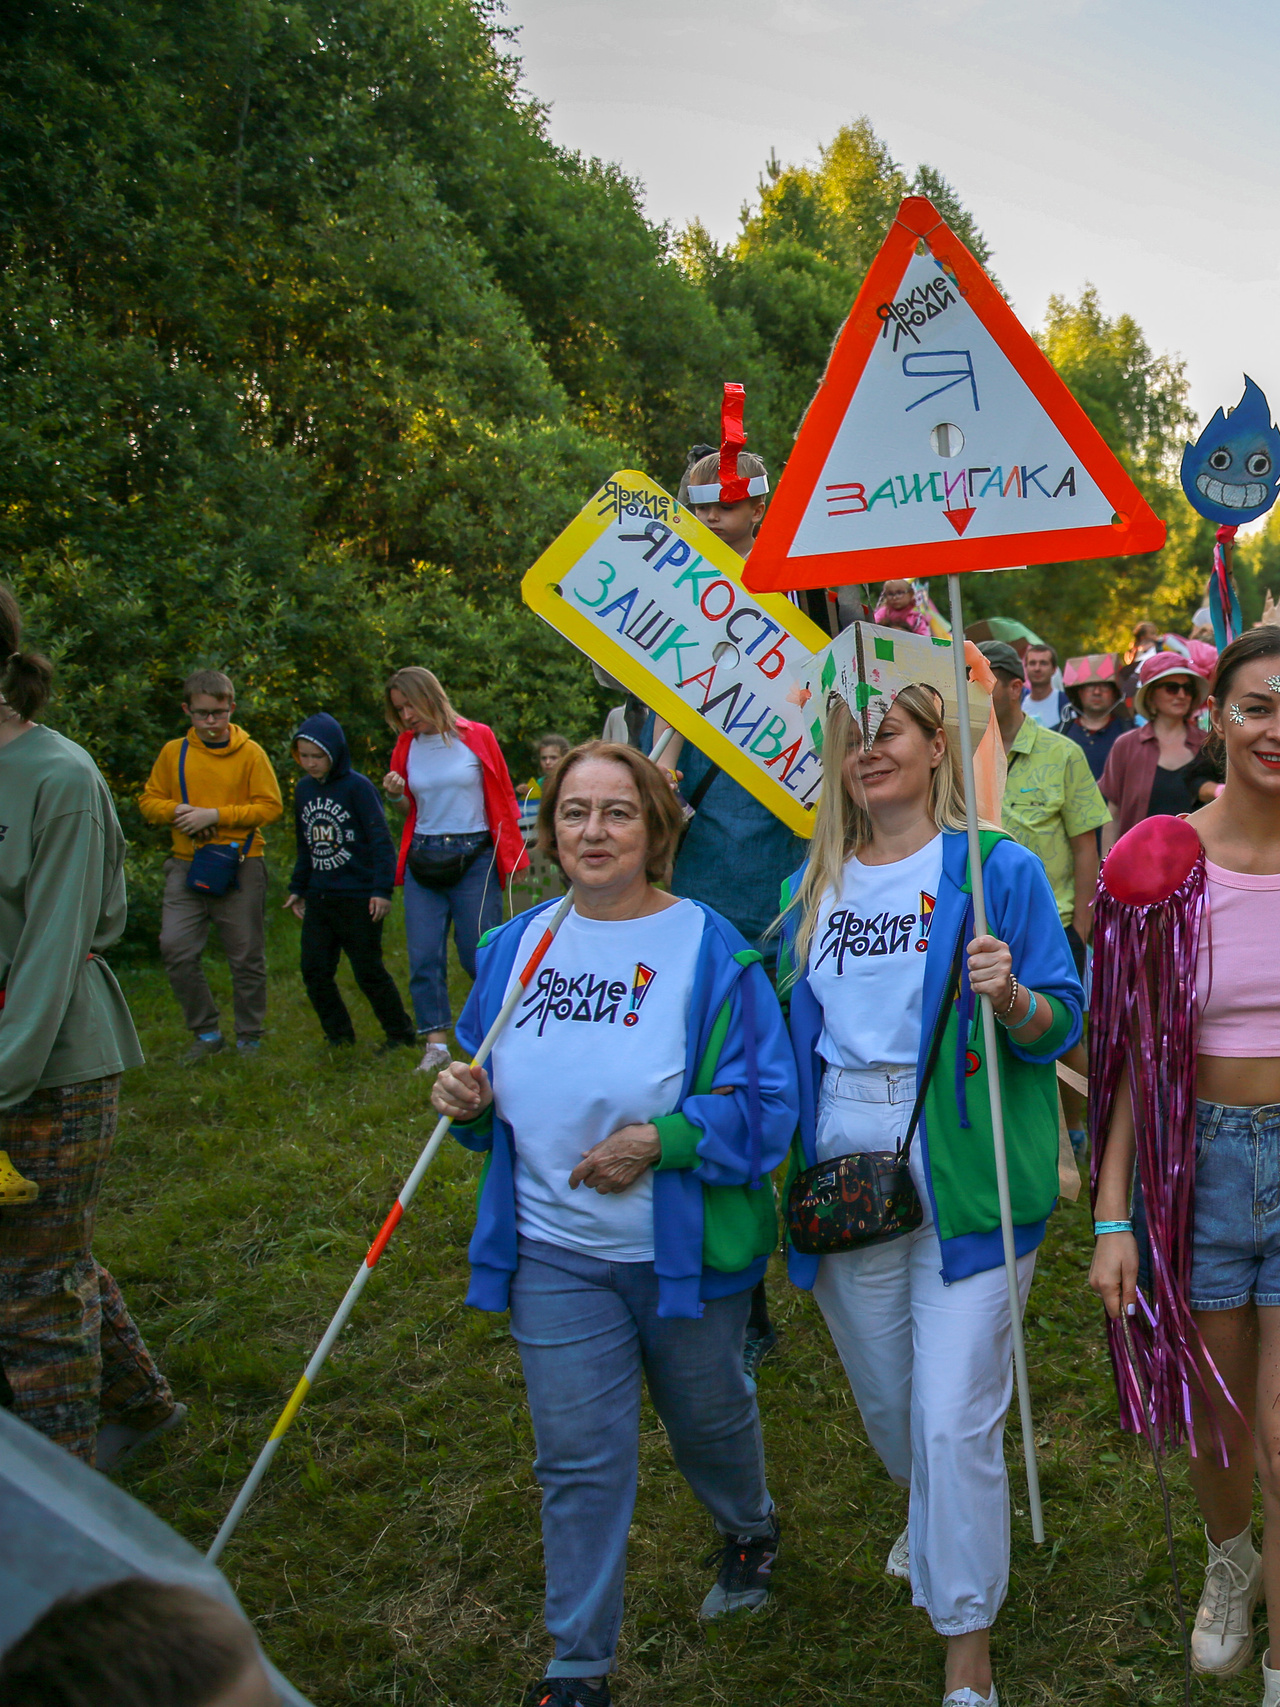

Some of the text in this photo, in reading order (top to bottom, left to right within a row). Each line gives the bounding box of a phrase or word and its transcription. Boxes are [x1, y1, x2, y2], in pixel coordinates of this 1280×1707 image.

[901, 349, 980, 412] Я
[825, 463, 1077, 517] ЗАЖИГАЛКА
[617, 520, 791, 680] ЯРКОСТЬ
[301, 796, 351, 824] COLLEGE
